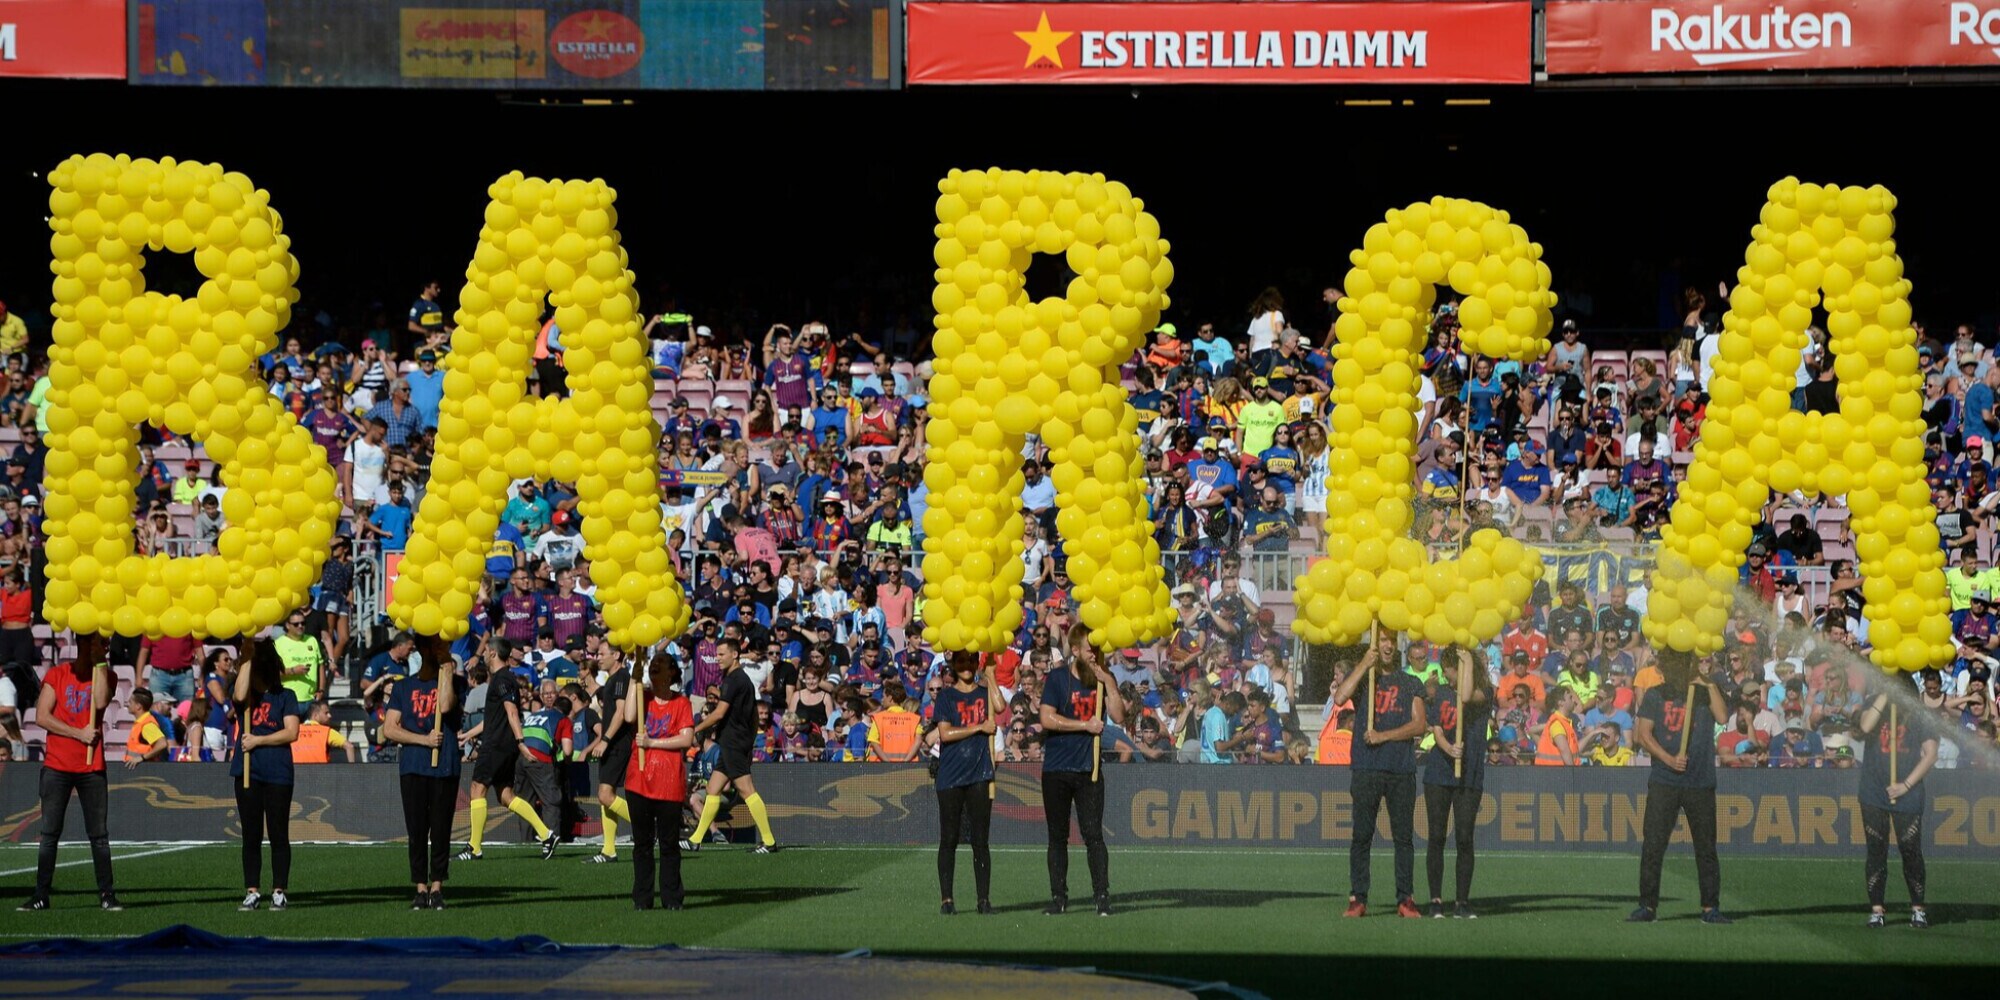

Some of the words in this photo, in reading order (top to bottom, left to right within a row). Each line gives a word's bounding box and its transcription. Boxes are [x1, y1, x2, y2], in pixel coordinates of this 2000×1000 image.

[558, 42, 635, 53] ESTRELLA
[1651, 4, 1852, 51] Rakuten
[1080, 30, 1285, 68] ESTRELLA
[1293, 30, 1428, 68] DAMM
[1718, 793, 1900, 846] PART
